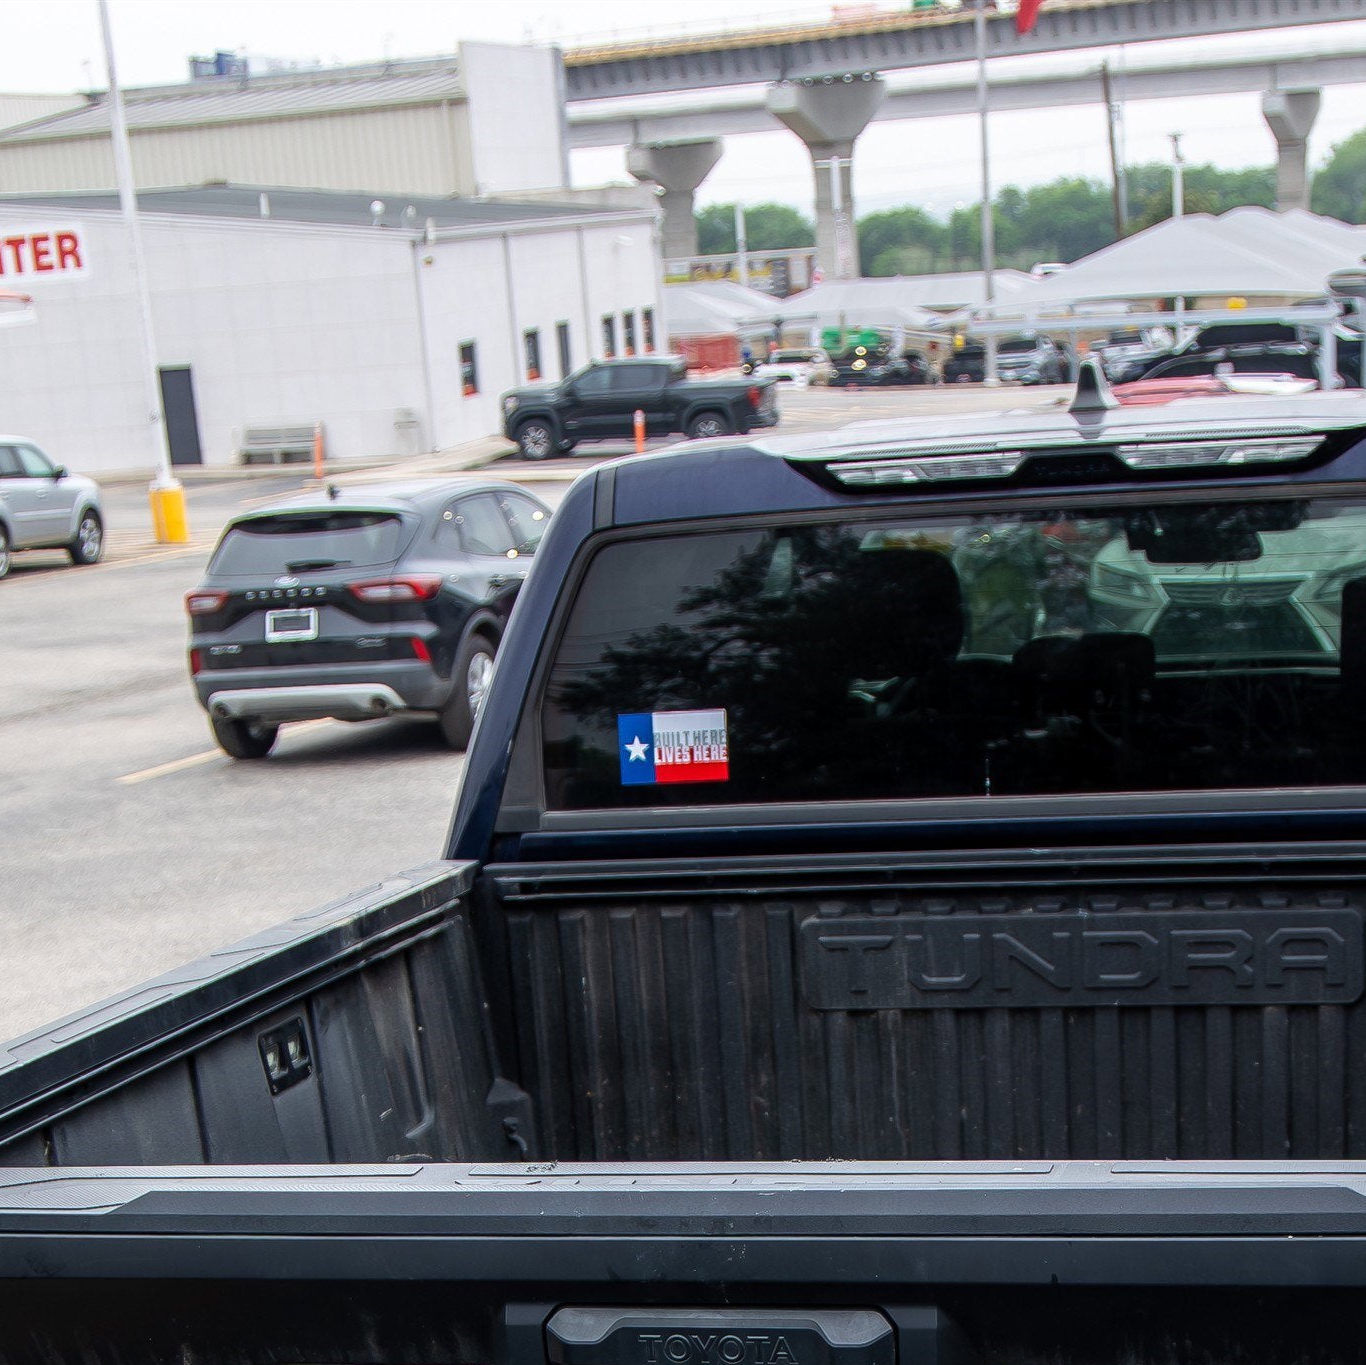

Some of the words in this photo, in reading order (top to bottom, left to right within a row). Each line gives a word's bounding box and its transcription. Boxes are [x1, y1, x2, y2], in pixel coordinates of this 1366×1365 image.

[653, 730, 690, 748] BUILT
[692, 728, 727, 746] HERE
[653, 745, 692, 765] LIVES
[692, 743, 729, 763] HERE
[818, 926, 1345, 994] TUNDRA
[638, 1333, 800, 1365] TOYOTA
